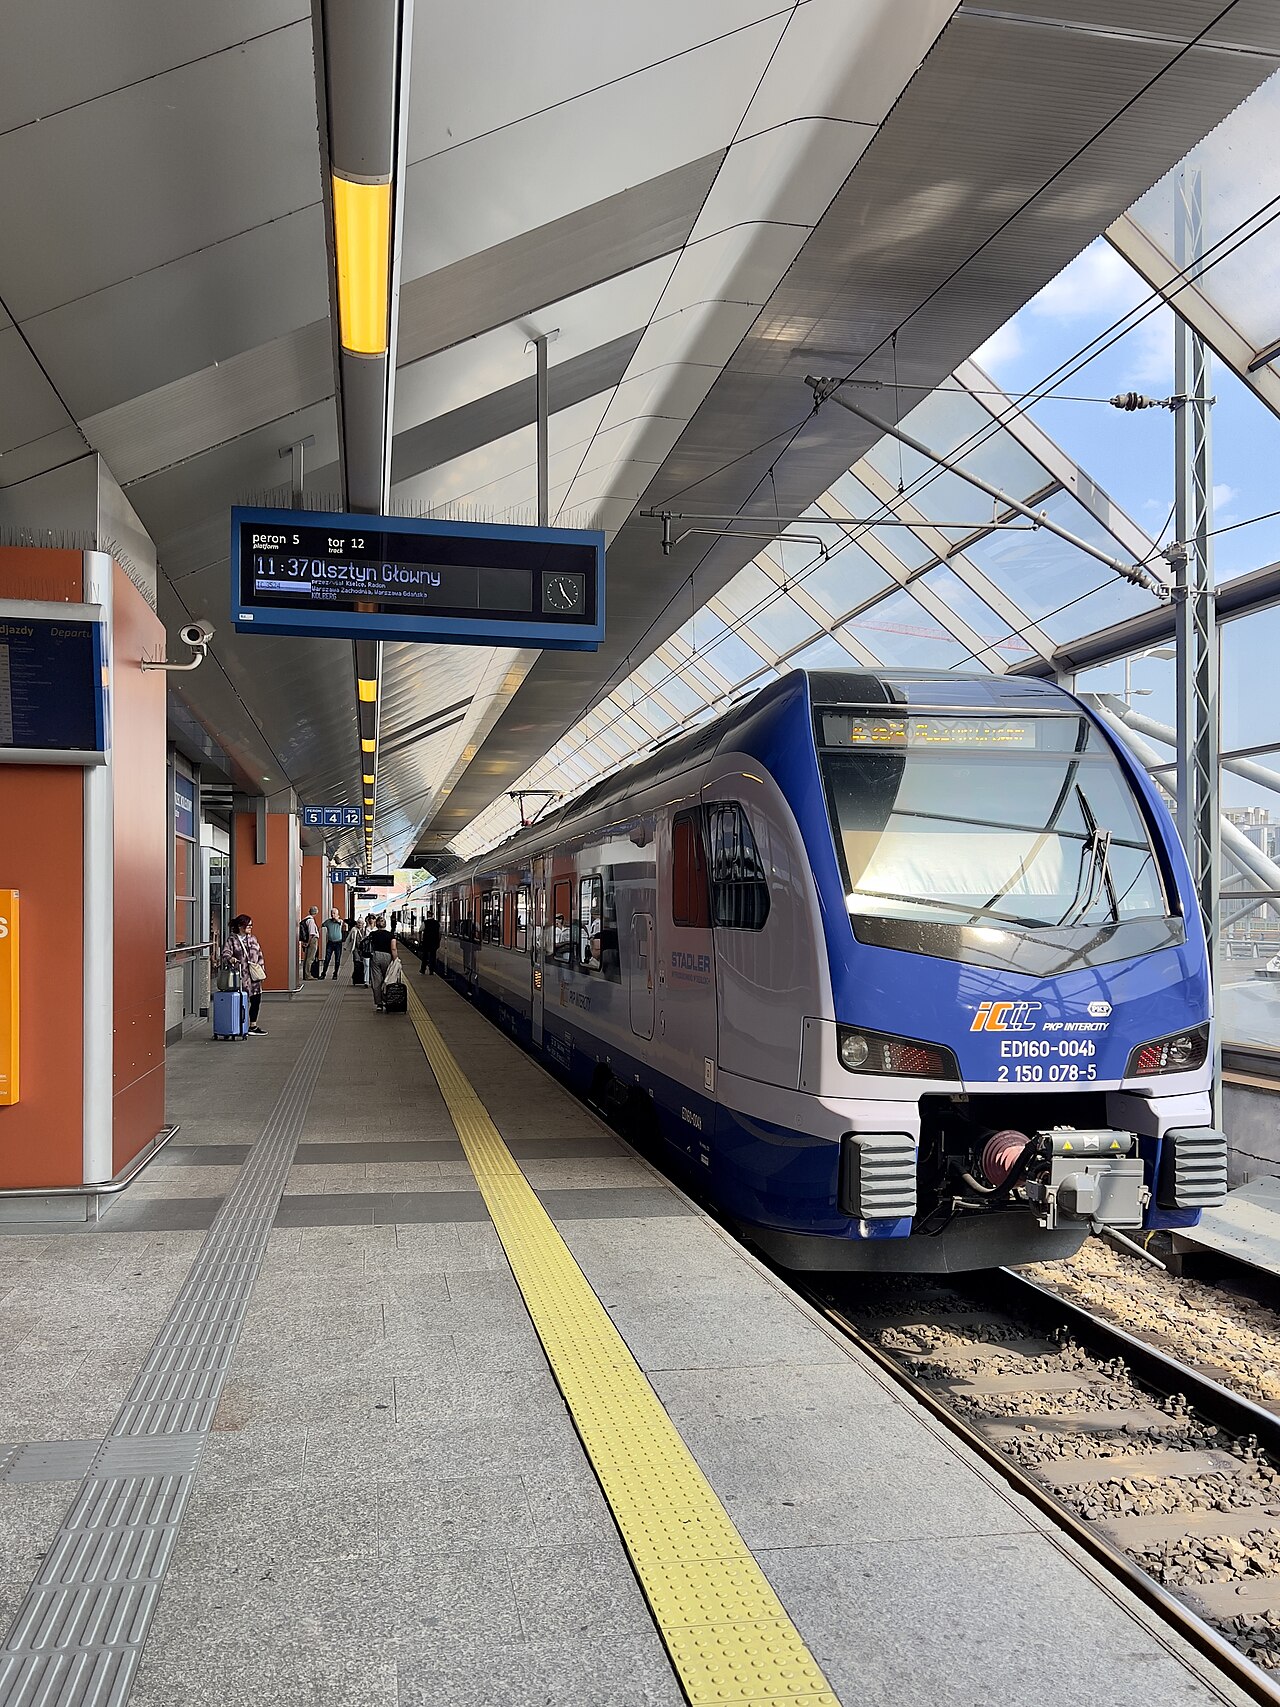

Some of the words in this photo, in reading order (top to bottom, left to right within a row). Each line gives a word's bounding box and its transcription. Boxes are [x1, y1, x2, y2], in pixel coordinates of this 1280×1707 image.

[252, 534, 286, 544] peron
[292, 534, 300, 545] 5
[328, 538, 345, 548] tor
[351, 538, 365, 549] 12
[257, 556, 308, 577] 11:37
[311, 560, 377, 582] Olsztyn
[382, 563, 440, 587] Główny
[310, 814, 318, 823] 5
[329, 814, 337, 823] 4
[345, 814, 358, 823] 12
[672, 952, 710, 973] STADLER
[1042, 1022, 1063, 1031] PKP
[1064, 1022, 1110, 1031] INTERCITY
[1000, 1040, 1096, 1058] ED160-004b
[998, 1066, 1009, 1082] 2
[1015, 1065, 1043, 1082] 150
[1048, 1064, 1097, 1081] 078-5
